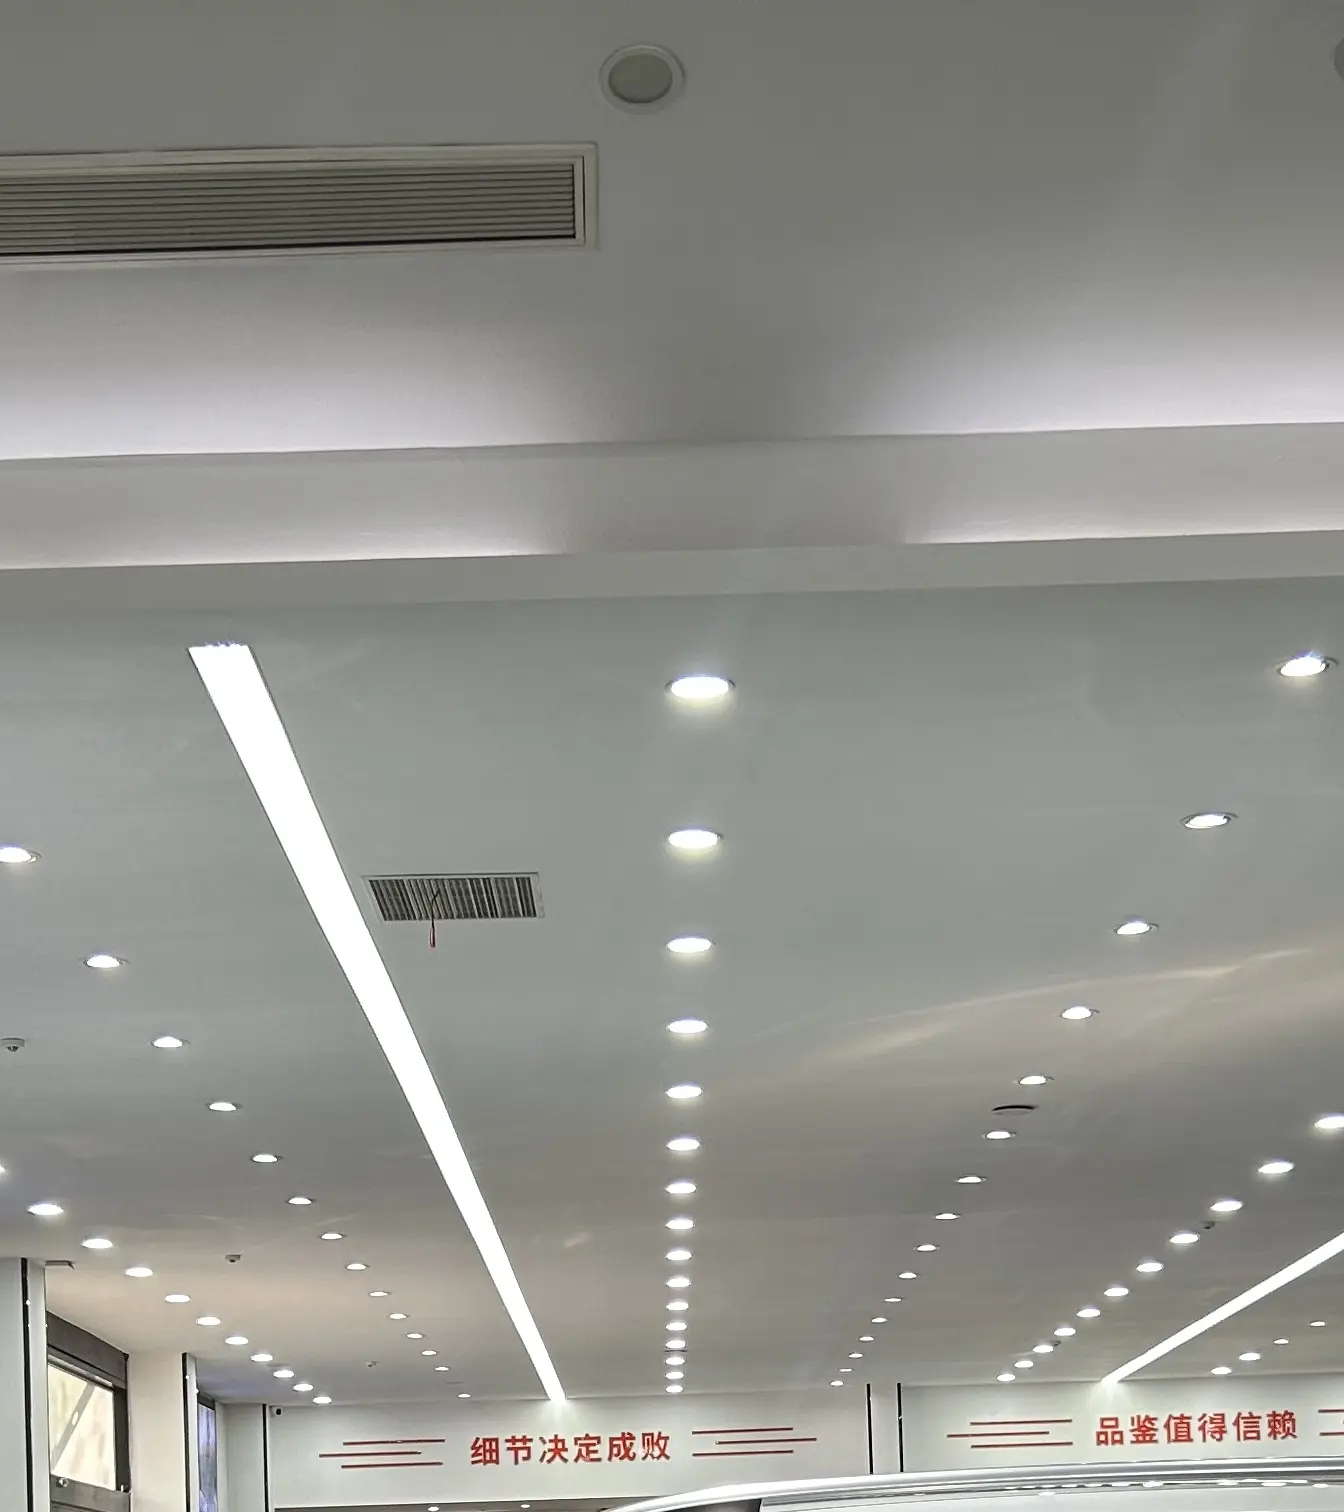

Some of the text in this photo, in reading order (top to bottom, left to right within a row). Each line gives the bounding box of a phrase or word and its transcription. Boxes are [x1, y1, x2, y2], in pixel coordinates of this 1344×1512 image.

[1095, 1409, 1298, 1447] 品鉴值得信赖
[470, 1432, 672, 1466] 细节决定成败
